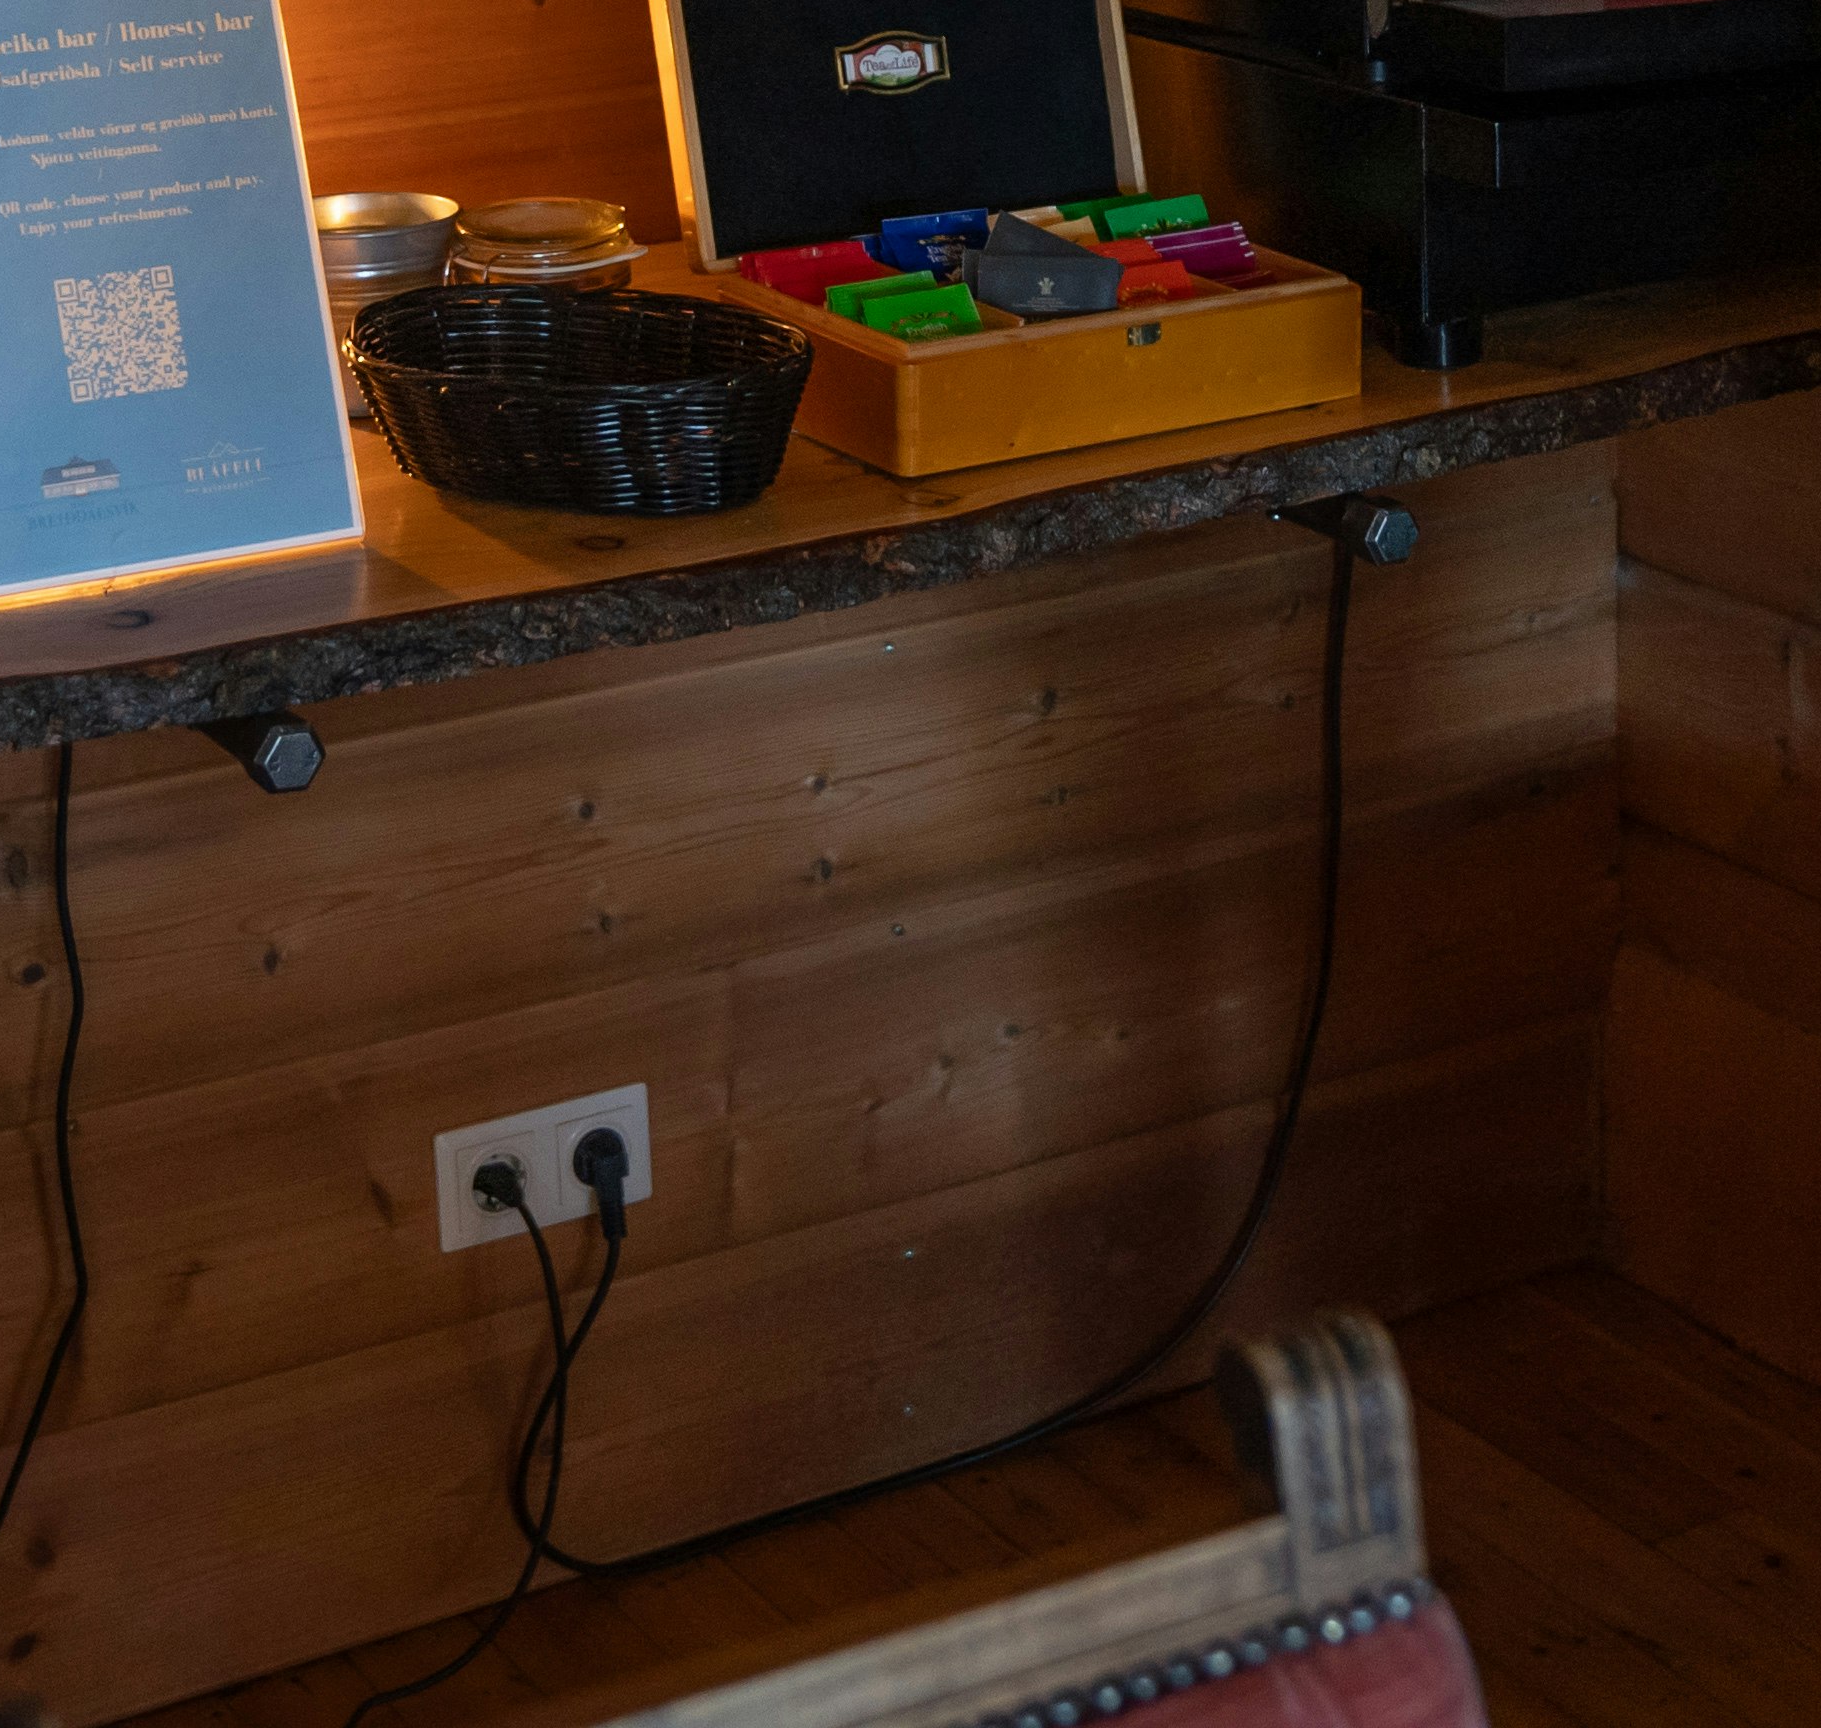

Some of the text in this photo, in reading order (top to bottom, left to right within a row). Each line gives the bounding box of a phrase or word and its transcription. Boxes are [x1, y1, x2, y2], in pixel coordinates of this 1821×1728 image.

[56, 29, 97, 49] bar
[119, 20, 207, 42] Honesty
[214, 11, 254, 32] bar
[119, 55, 154, 73] Self
[159, 50, 224, 69] service
[863, 59, 885, 72] Tea
[894, 55, 918, 70] Life
[0, 201, 21, 218] QR
[149, 181, 201, 201] product
[206, 175, 231, 190] and
[19, 222, 57, 237] Enjoy
[62, 216, 94, 234] your
